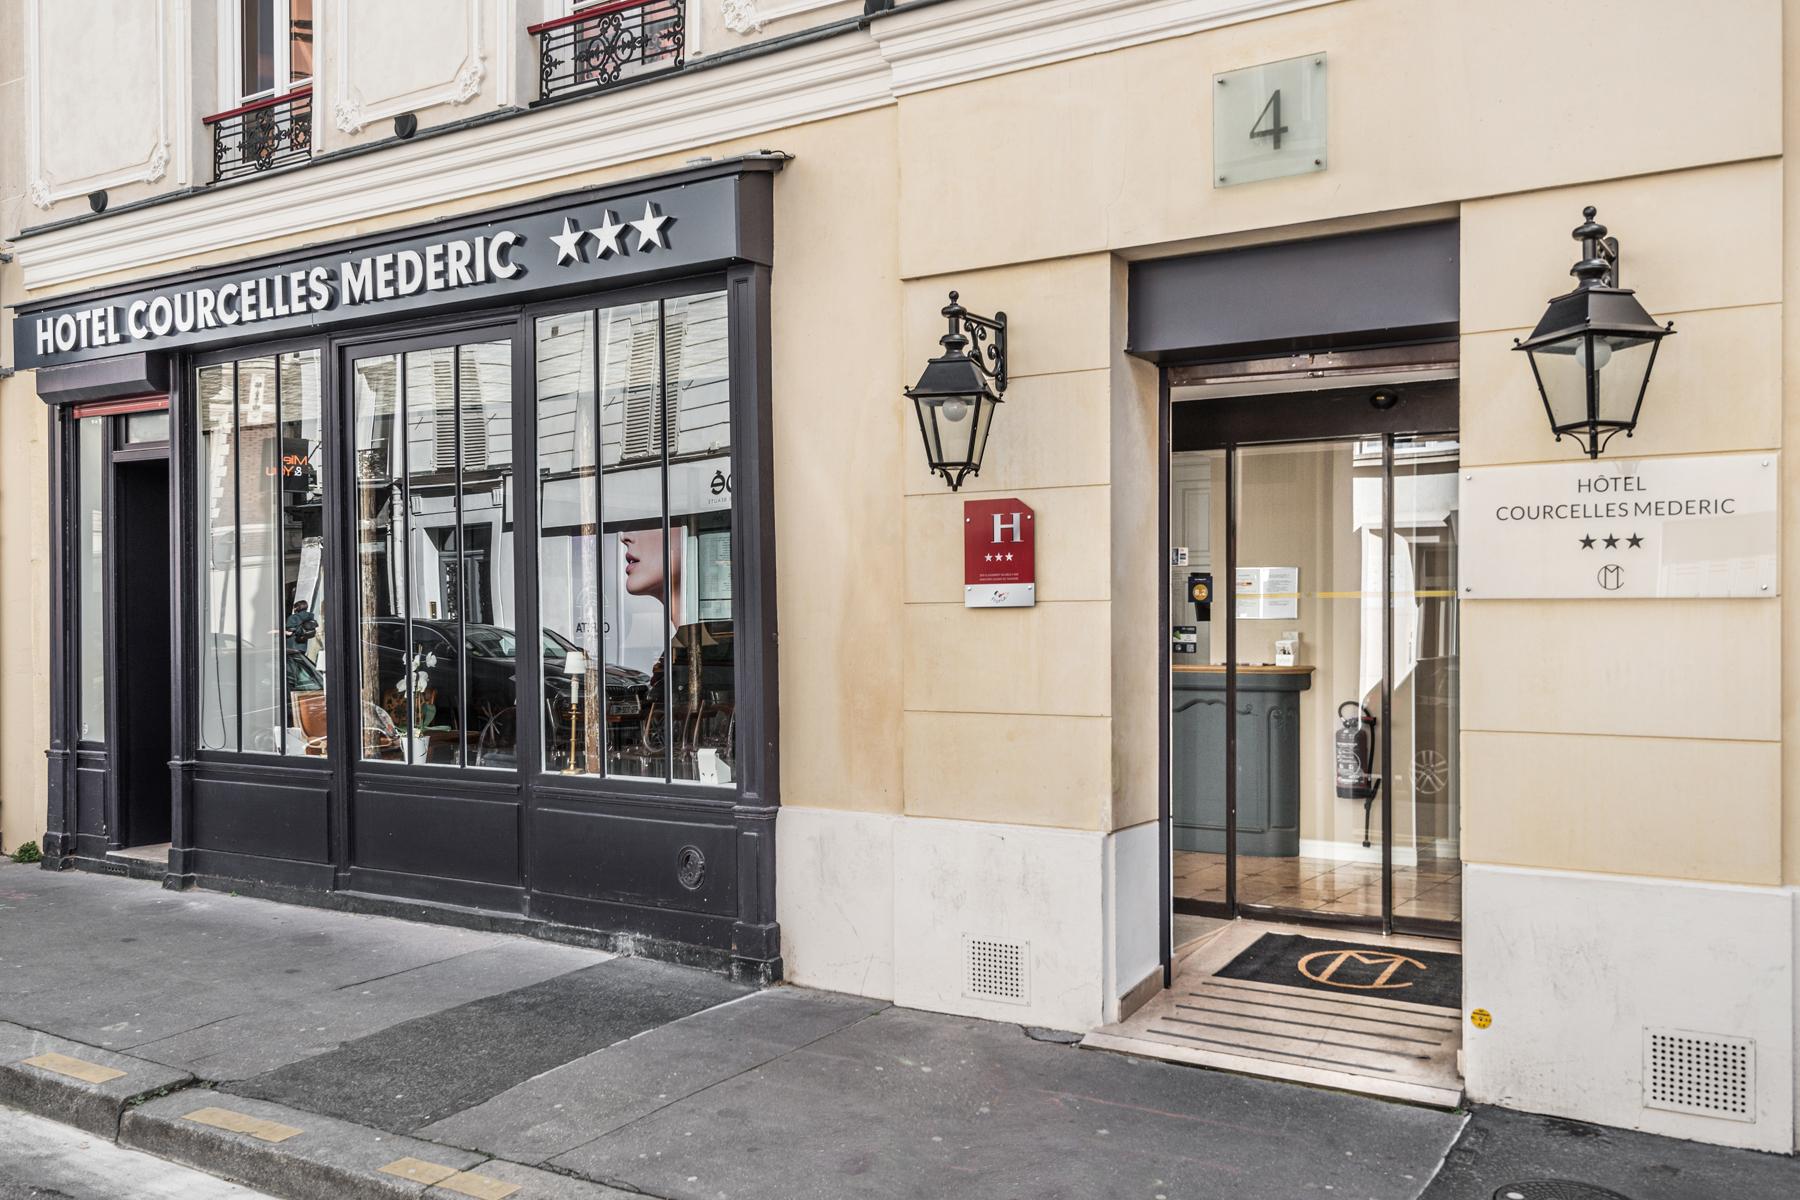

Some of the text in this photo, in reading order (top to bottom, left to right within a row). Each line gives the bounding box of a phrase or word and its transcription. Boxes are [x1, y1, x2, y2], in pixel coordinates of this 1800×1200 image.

[1249, 89, 1289, 150] 4
[36, 230, 522, 356] HOTEL COURCELLES MEDERIC
[1577, 474, 1647, 493] HÔTEL
[1496, 498, 1736, 521] COURCELLES MEDERIC
[991, 512, 1024, 544] H
